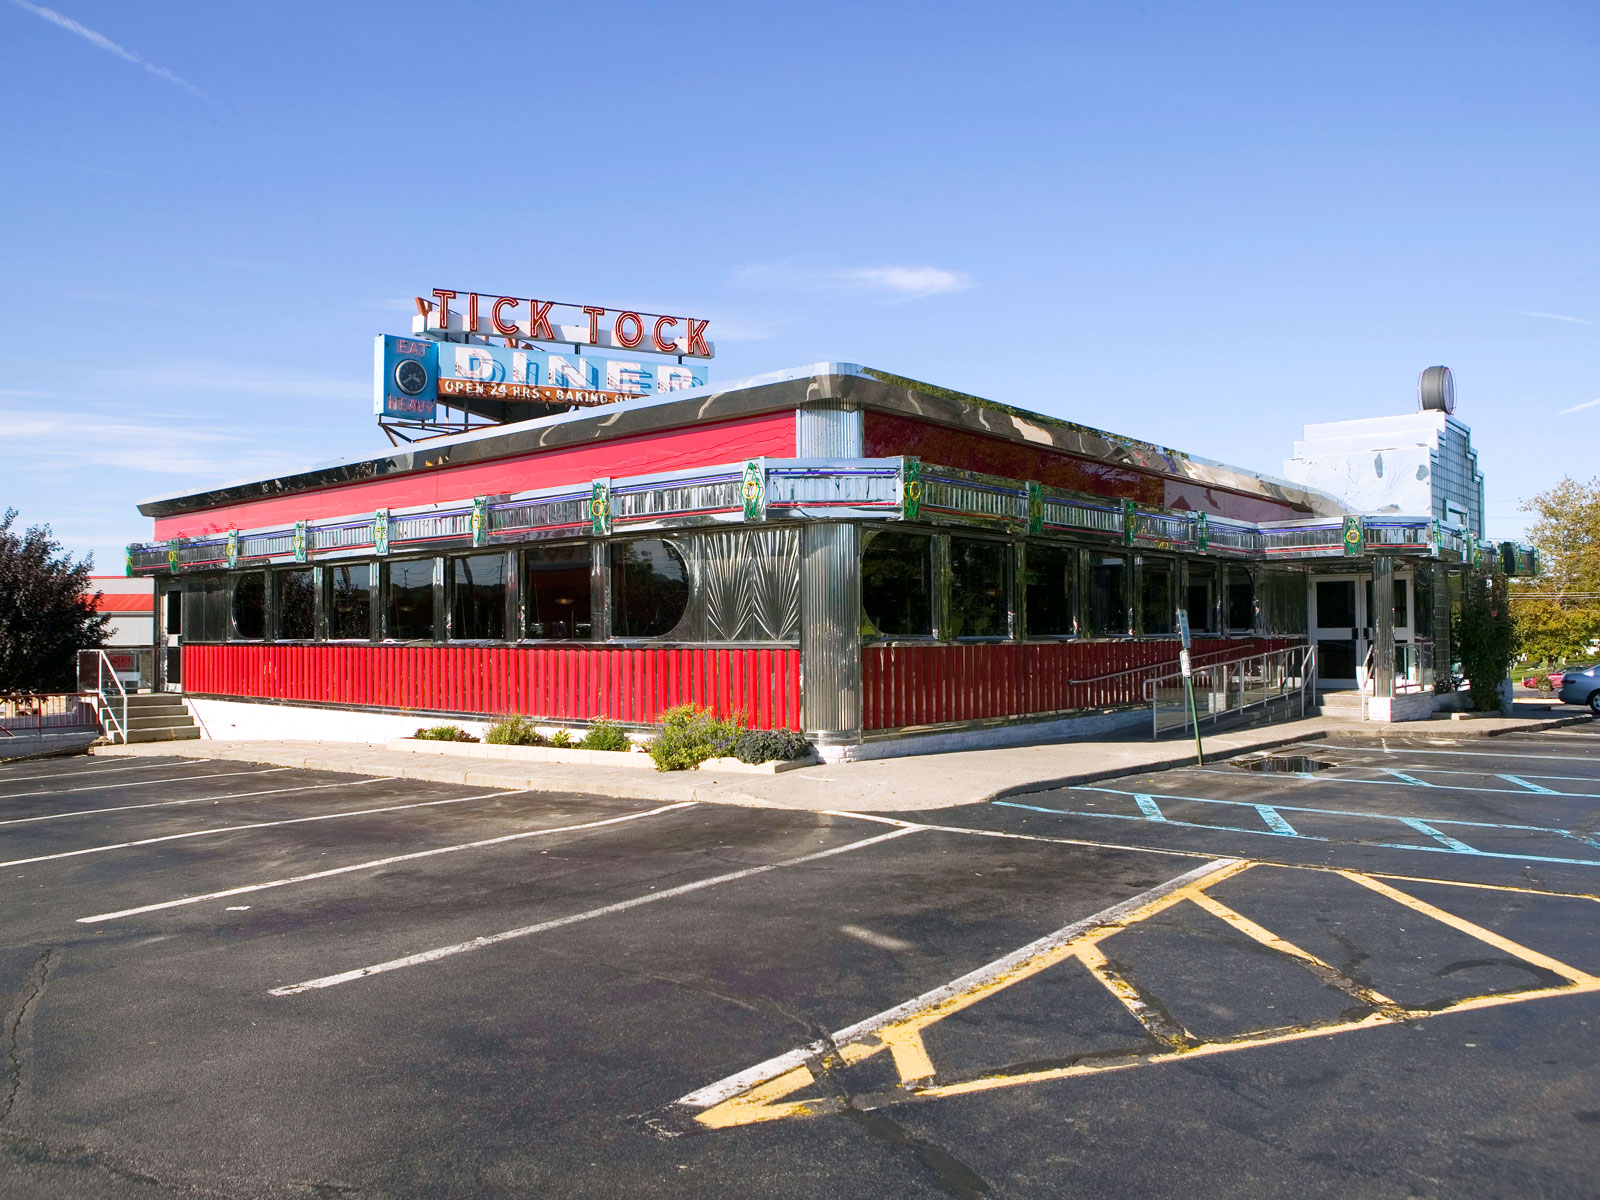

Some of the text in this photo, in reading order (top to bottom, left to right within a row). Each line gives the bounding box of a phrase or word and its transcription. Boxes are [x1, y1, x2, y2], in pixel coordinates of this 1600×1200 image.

[432, 288, 711, 357] TICK TOCK
[398, 339, 431, 356] EAT
[455, 347, 693, 393] DINER
[387, 394, 436, 413] HEAVY
[444, 380, 484, 394] OPEN
[490, 383, 507, 396] 24
[513, 386, 540, 399] HRS
[556, 389, 608, 404] BAKING
